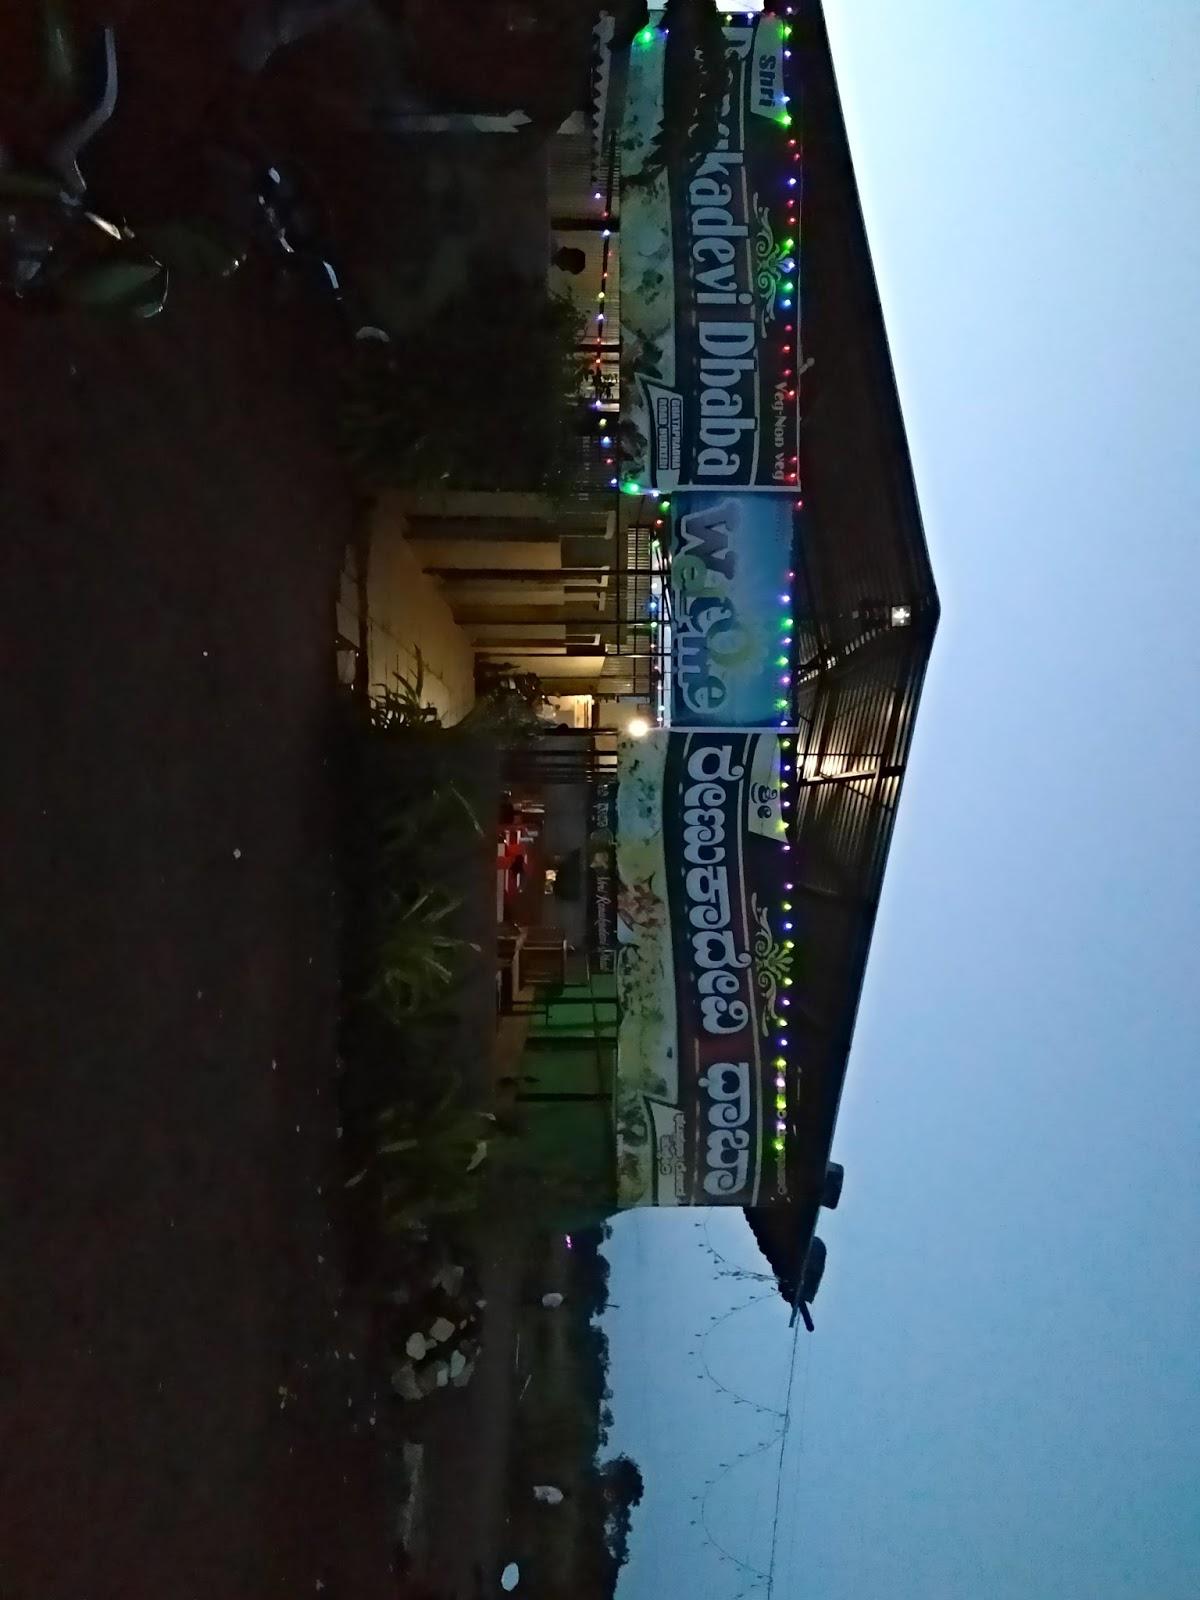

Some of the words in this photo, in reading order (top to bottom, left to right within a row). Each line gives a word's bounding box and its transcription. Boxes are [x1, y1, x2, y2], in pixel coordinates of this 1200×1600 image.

[758, 55, 777, 107] Shri
[696, 321, 756, 476] Dhaba
[772, 452, 786, 480] veg
[751, 783, 778, 819] ಶ್ರೀ
[683, 745, 752, 1035] ರೇಣುಕಾದೇವಿ
[698, 1062, 750, 1196] ಧಾಬಾ
